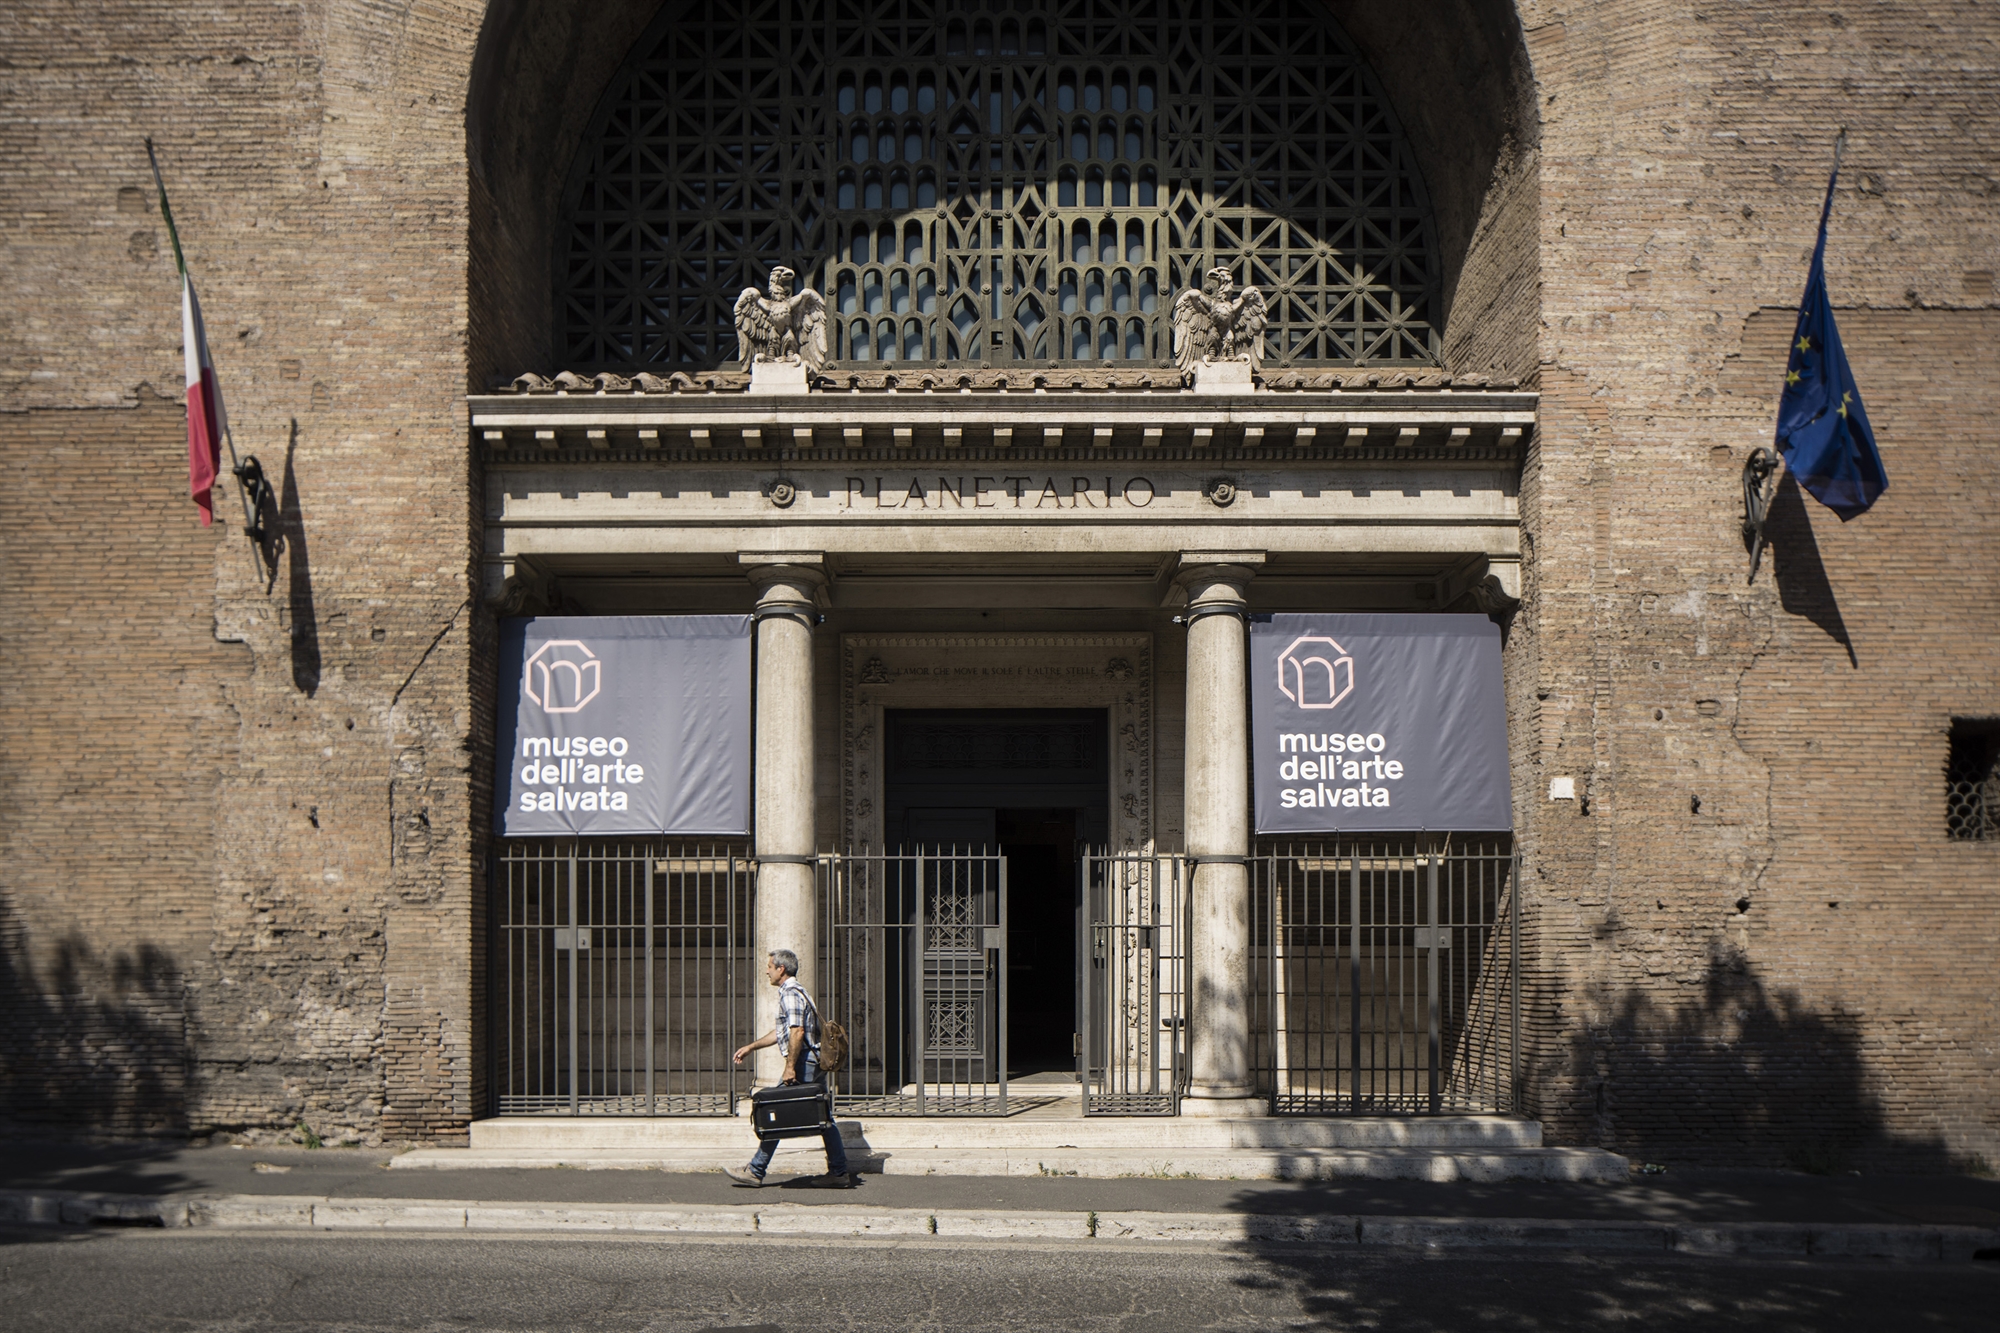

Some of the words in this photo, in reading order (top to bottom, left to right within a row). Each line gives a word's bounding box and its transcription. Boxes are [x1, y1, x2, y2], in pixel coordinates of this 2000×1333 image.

[845, 476, 1155, 509] PLANETARIO
[932, 667, 951, 676] CHE
[953, 667, 978, 676] MOVE
[981, 667, 989, 676] IL
[991, 667, 1013, 676] SOLE
[1065, 666, 1096, 676] STELLE
[521, 736, 629, 757] museo
[1279, 733, 1386, 753] museo
[519, 786, 628, 812] salvata
[1280, 782, 1391, 808] salvata
